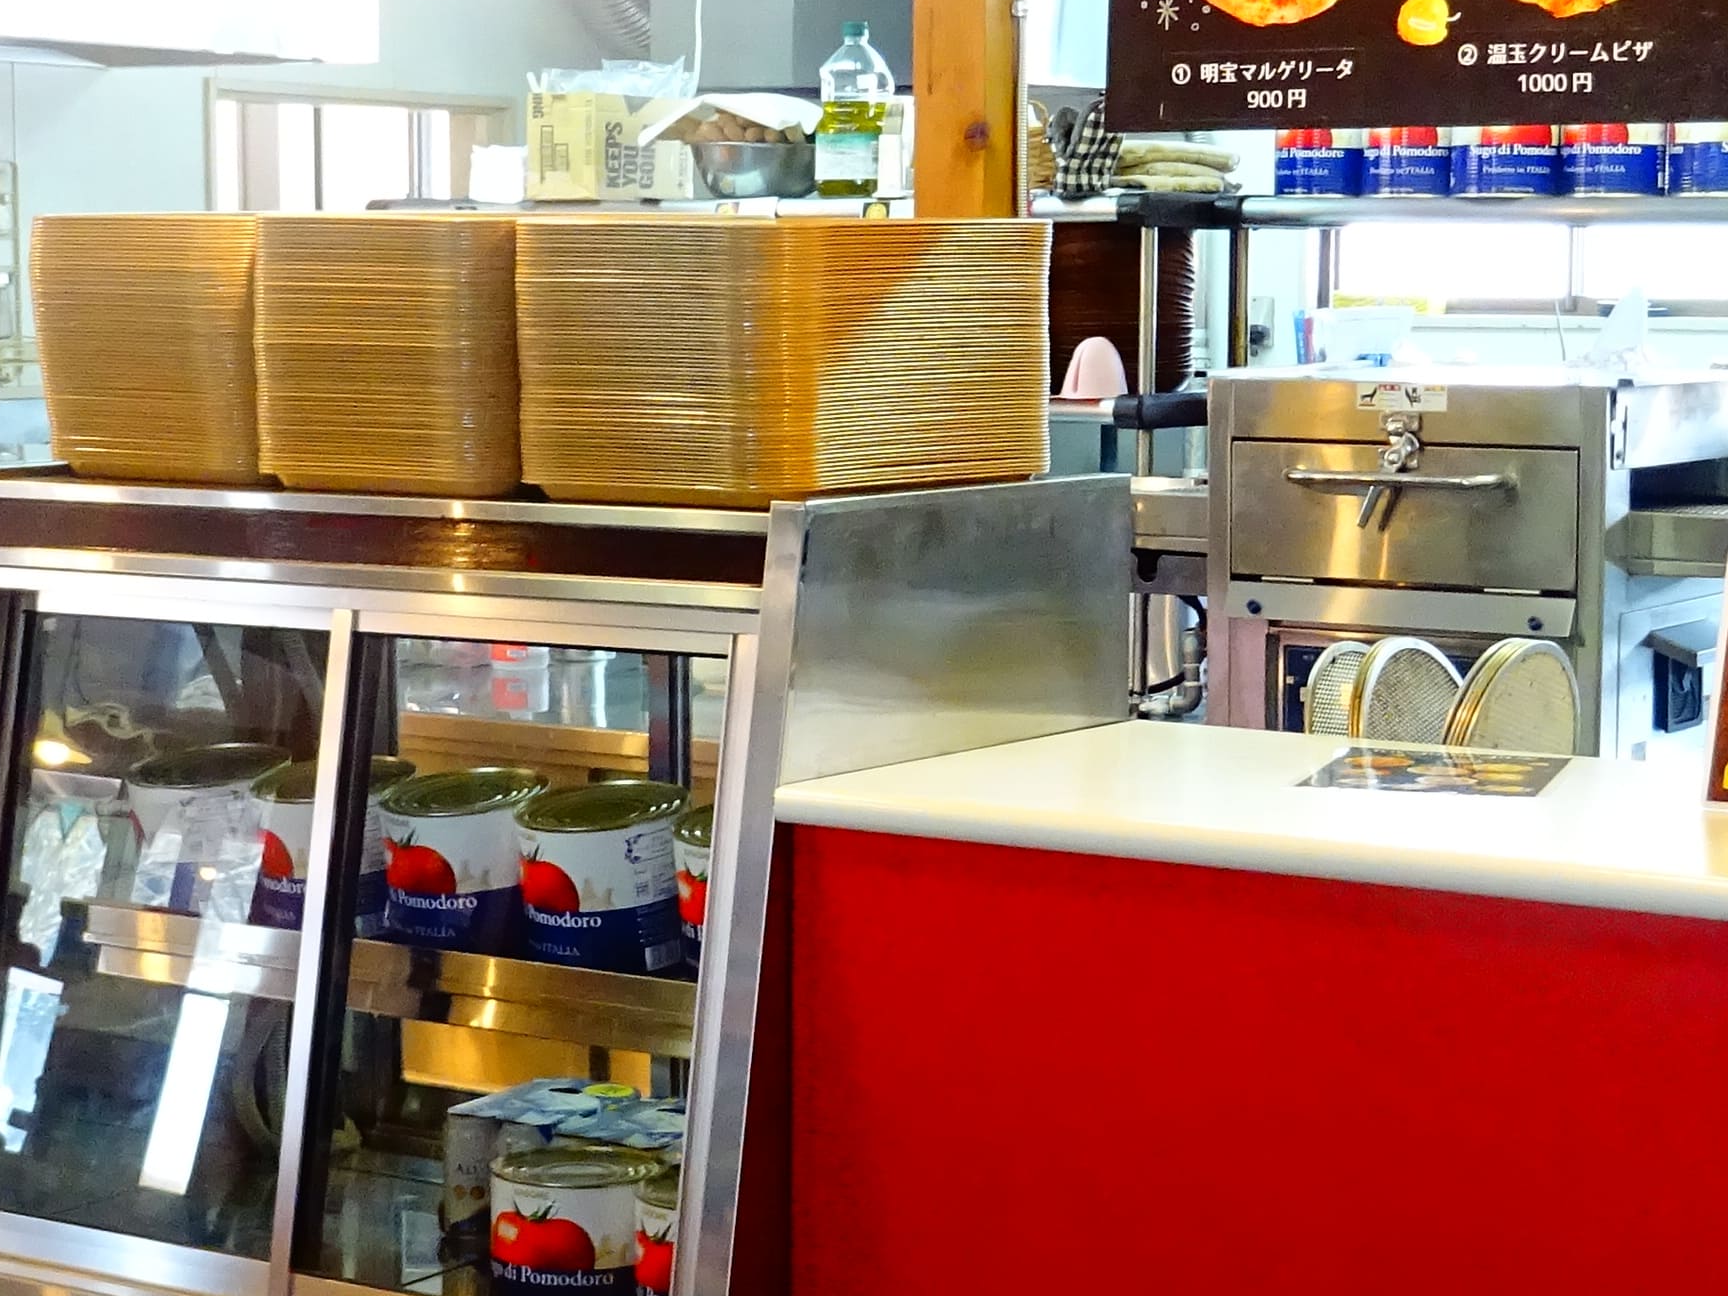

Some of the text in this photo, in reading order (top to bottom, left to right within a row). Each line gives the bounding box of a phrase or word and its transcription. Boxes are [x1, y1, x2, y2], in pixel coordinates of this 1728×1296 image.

[1486, 40, 1654, 66] 温玉クリームピザ
[1199, 60, 1354, 86] 明宝マルゲリータ
[604, 121, 624, 189] KEEPS
[622, 145, 640, 188] YOU
[398, 888, 478, 910] Pomodoro
[521, 1266, 614, 1287] Pomodoro
